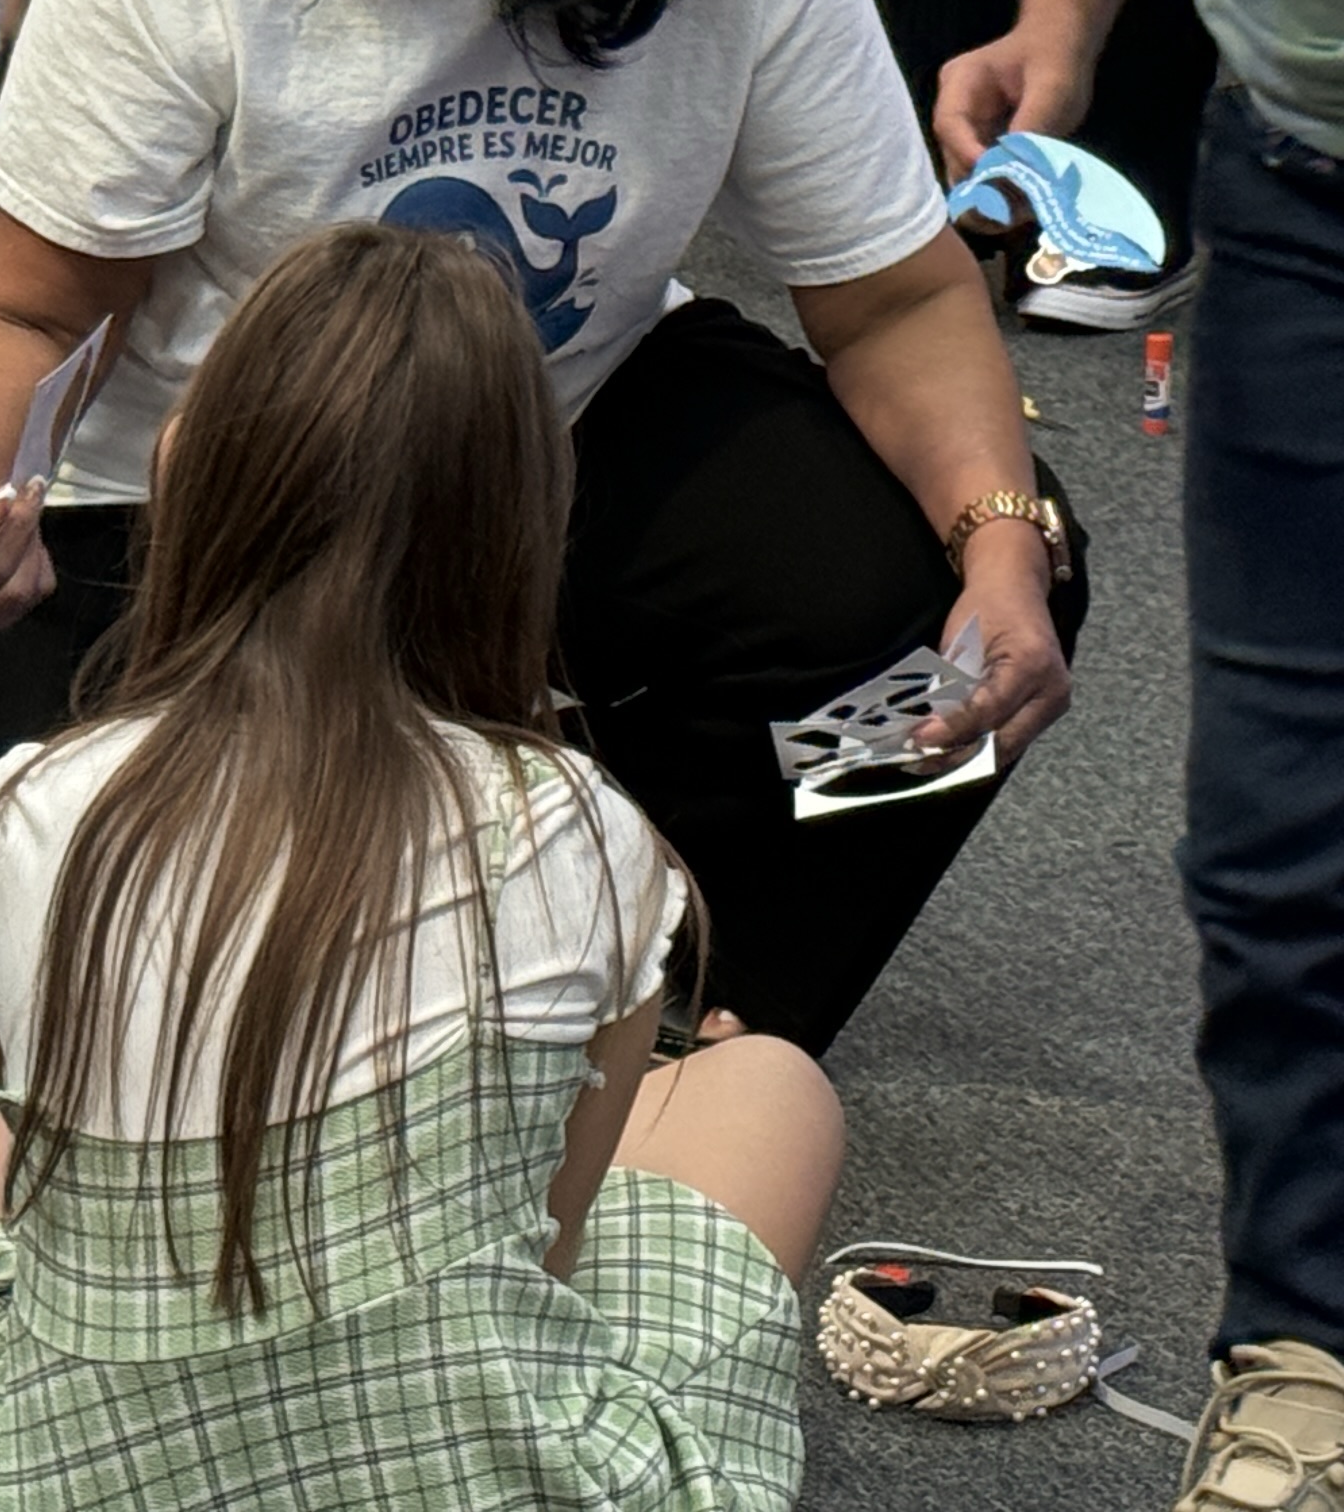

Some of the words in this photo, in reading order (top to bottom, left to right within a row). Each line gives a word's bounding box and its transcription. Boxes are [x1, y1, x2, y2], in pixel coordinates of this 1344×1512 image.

[389, 86, 587, 145] OBEDECER
[360, 133, 474, 188] SIEMPRE
[483, 131, 515, 159] ES
[523, 131, 618, 172] MEJOR
